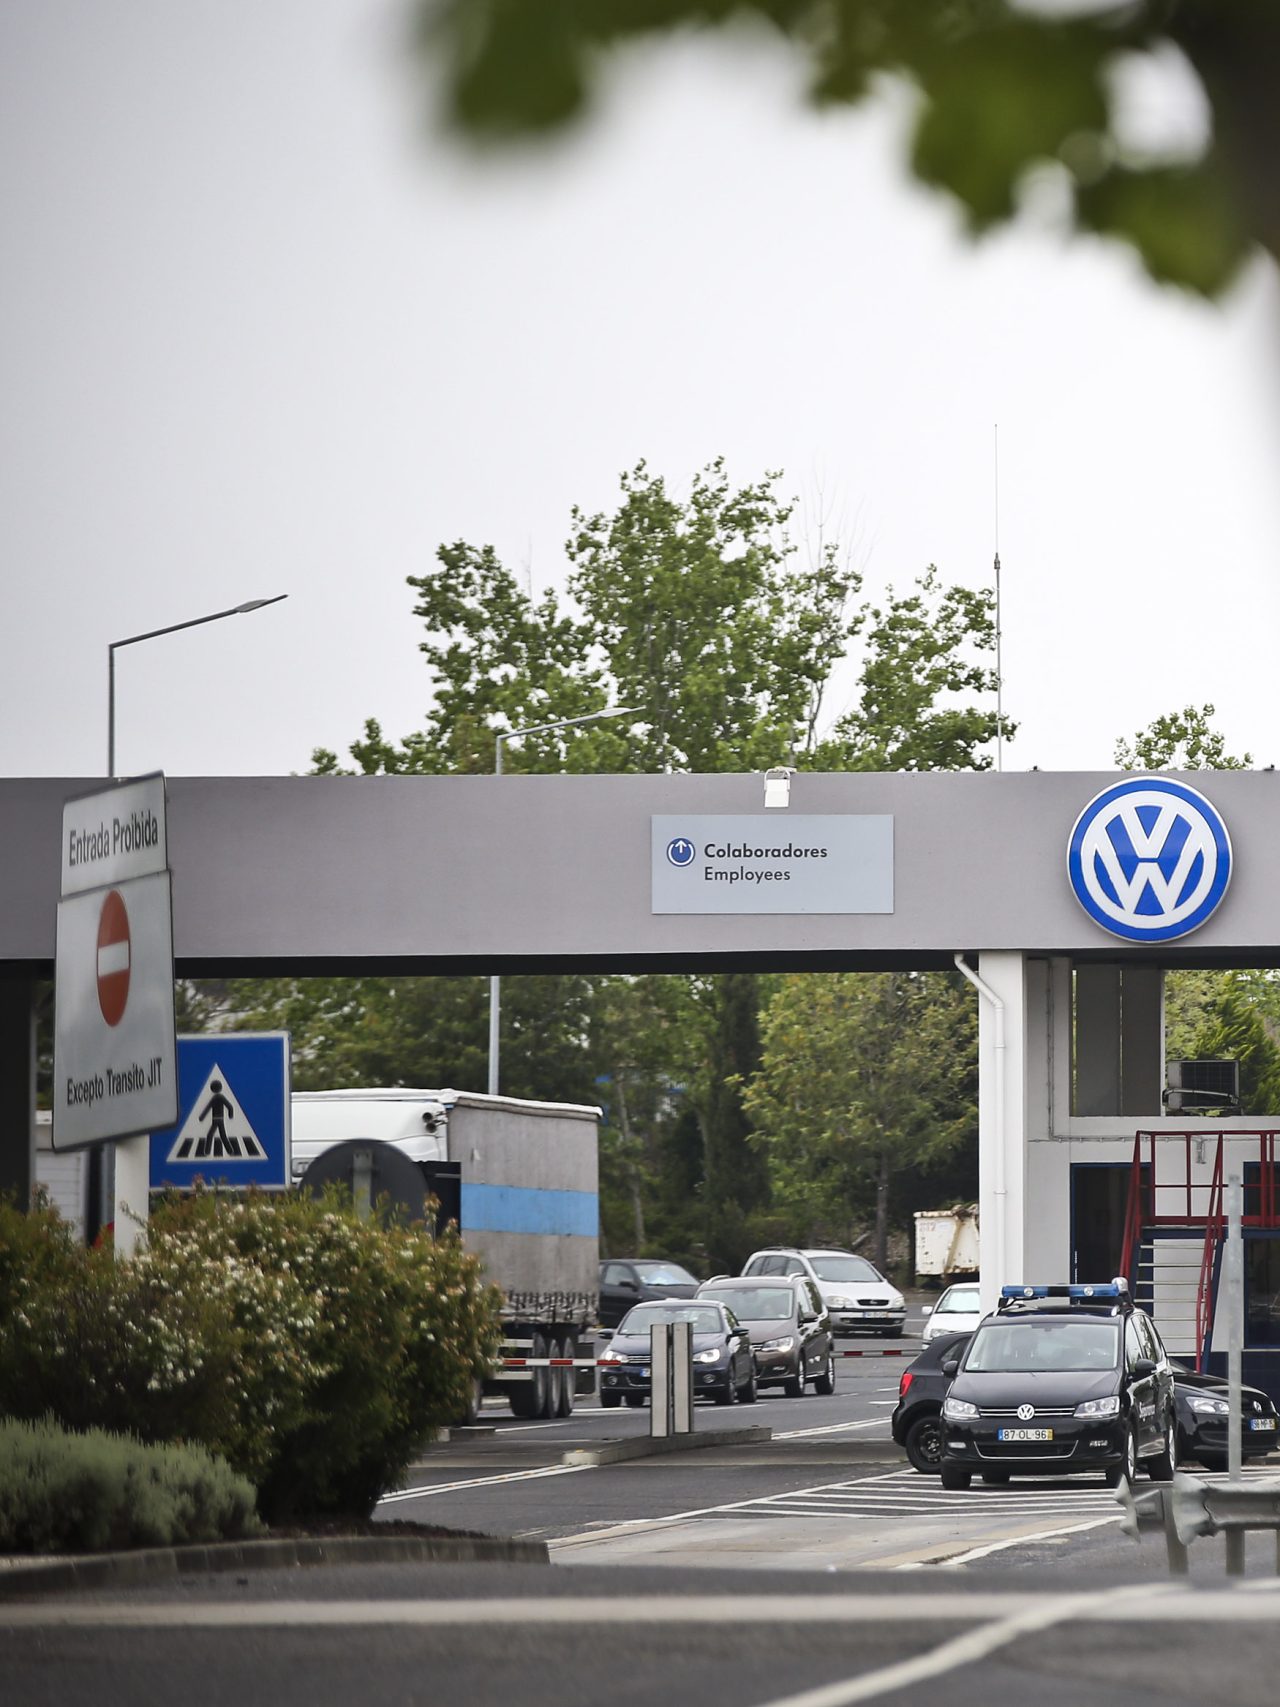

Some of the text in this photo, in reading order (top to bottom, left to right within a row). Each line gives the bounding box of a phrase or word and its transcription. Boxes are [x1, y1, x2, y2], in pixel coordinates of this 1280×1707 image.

[69, 808, 159, 867] Entrada Proibida
[704, 843, 828, 859] Colaboradores
[1081, 791, 1217, 929] VW
[704, 866, 791, 884] Employees
[67, 1057, 162, 1107] Excepto Transito JIT
